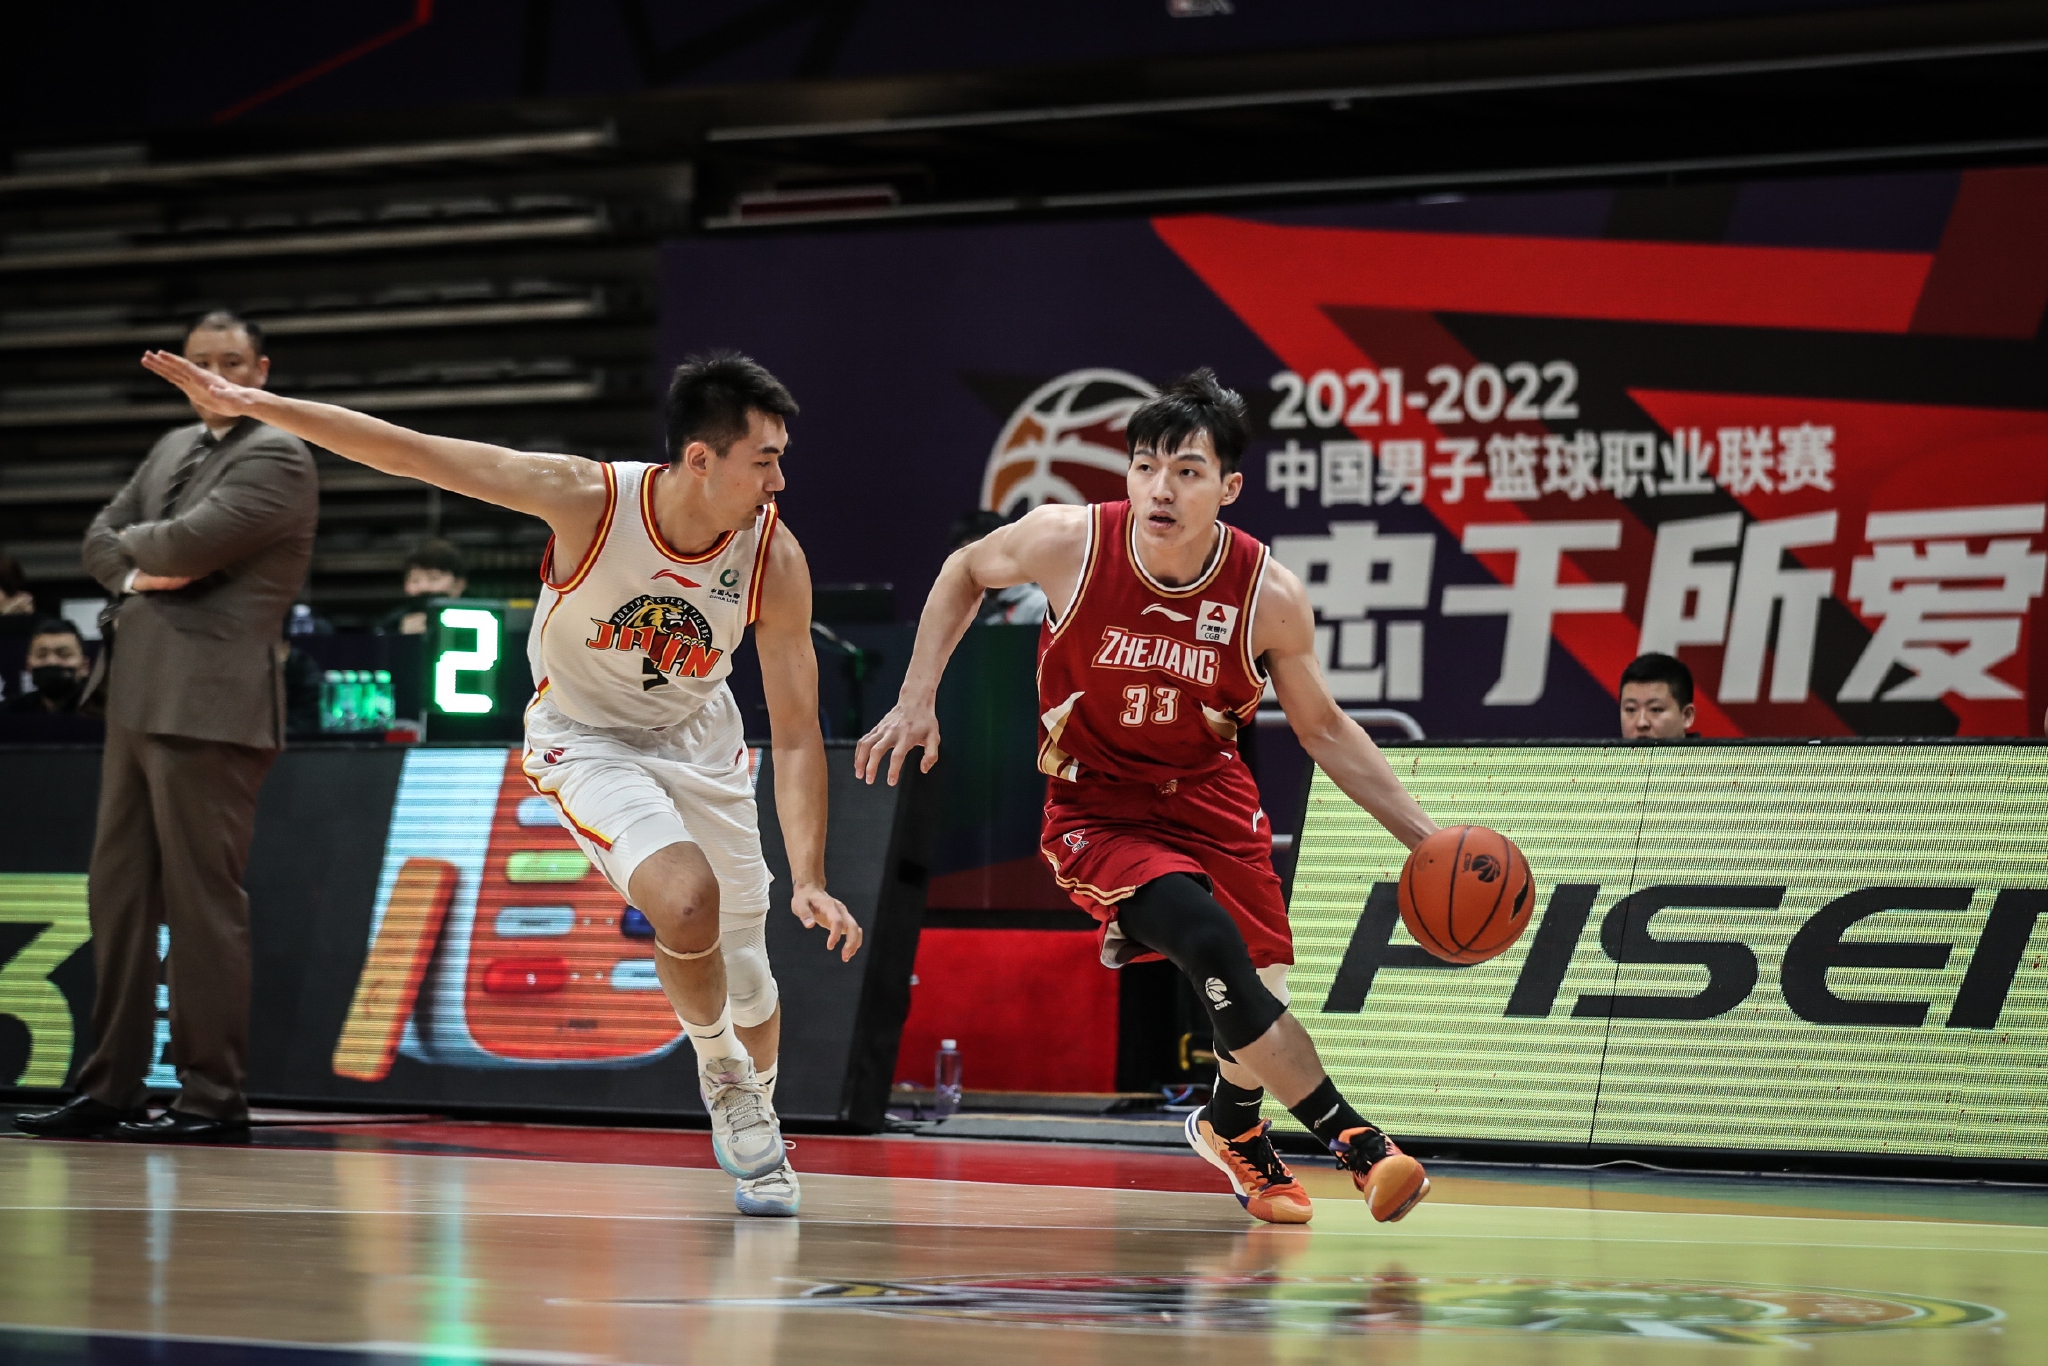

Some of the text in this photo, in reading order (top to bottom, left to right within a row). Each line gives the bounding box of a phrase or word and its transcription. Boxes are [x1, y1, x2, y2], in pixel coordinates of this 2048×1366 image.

[1269, 361, 1579, 429] 2021-2022
[1266, 424, 1835, 508] 中国男子篮球职业联赛
[1204, 632, 1220, 641] CGB
[1264, 503, 2048, 706] 忠于所爱
[435, 608, 499, 713] 2
[1096, 629, 1218, 686] ZHEJIANG
[1120, 685, 1180, 727] 33
